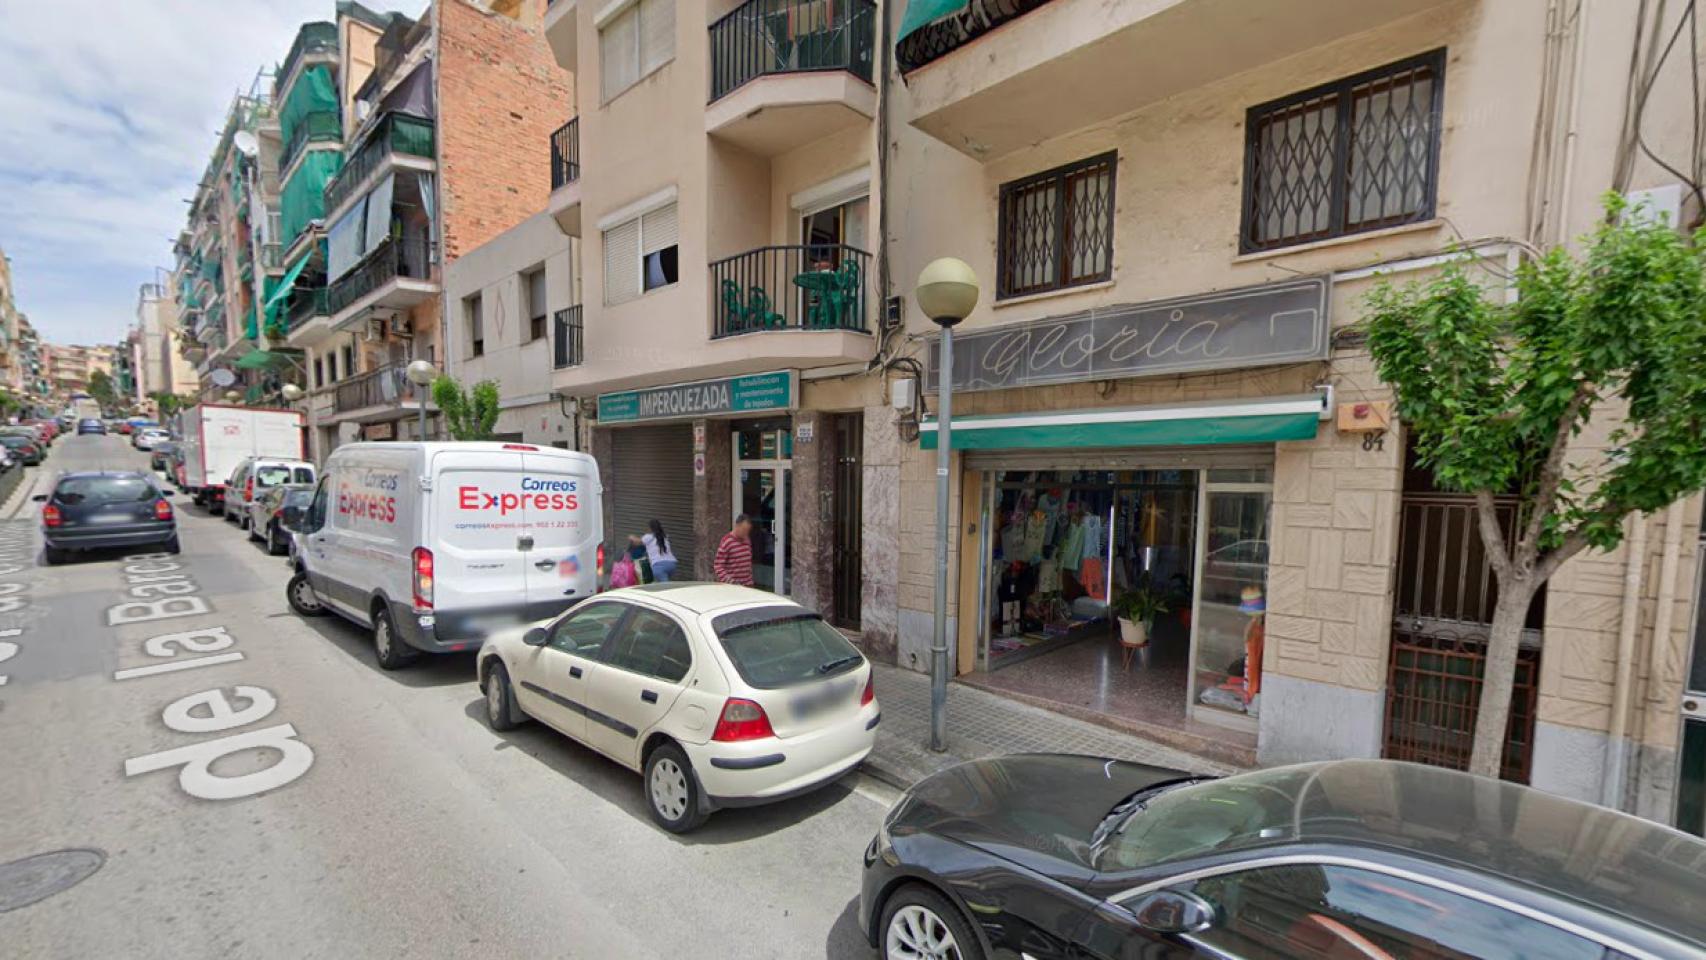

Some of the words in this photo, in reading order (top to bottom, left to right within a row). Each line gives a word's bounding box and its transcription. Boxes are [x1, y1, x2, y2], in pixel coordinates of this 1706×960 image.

[640, 384, 729, 417] IMPERQUEZADA
[521, 477, 577, 491] Correos
[339, 483, 396, 524] Express
[458, 486, 578, 516] Express
